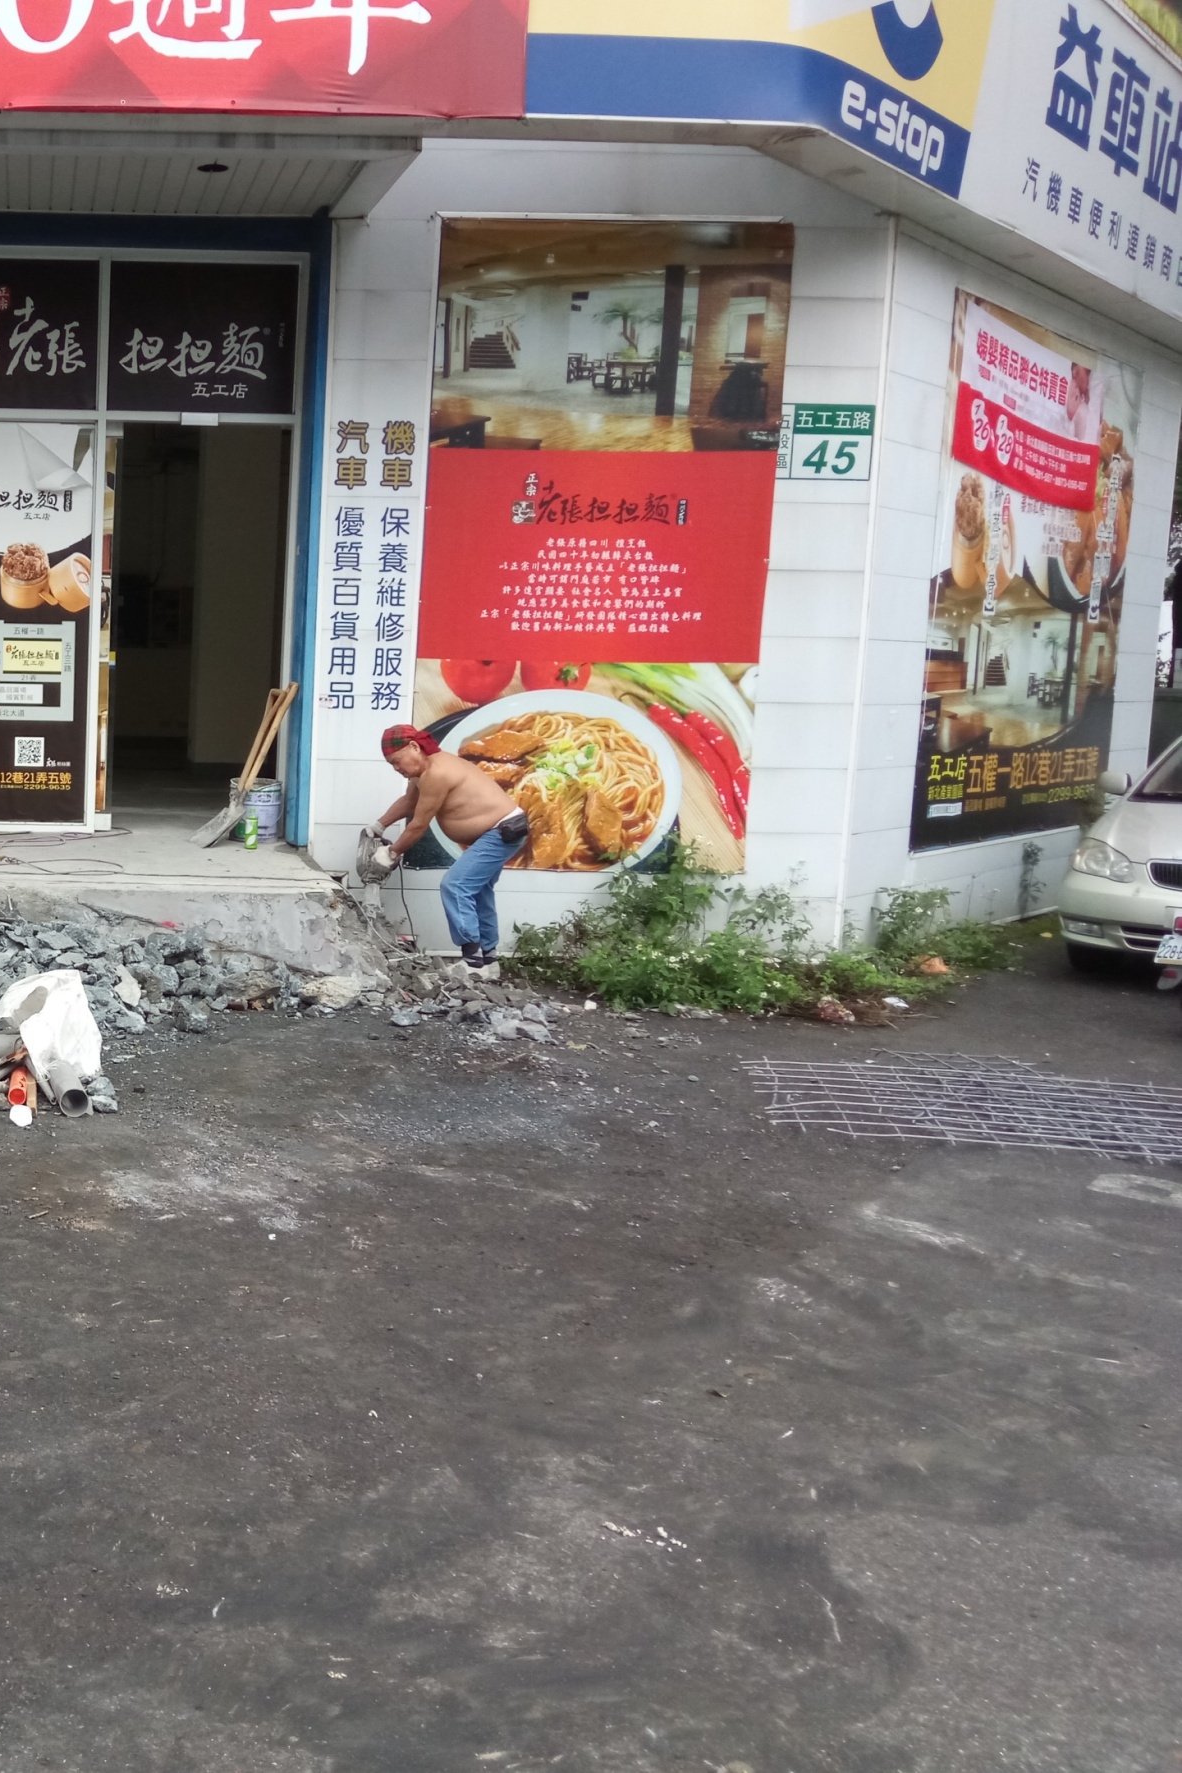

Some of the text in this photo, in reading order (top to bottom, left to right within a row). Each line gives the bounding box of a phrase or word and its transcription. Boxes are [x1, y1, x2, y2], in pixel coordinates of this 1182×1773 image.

[840, 79, 945, 176] e-stop
[191, 382, 249, 399] 五工店
[796, 411, 871, 429] 五工五路
[975, 418, 989, 440] 26
[998, 433, 1012, 455] 28
[802, 440, 859, 475] 45
[525, 472, 538, 496] 正宗
[327, 420, 369, 711] 汽車 優質百貨用品
[370, 420, 415, 711] 機車 保養維修服務
[927, 754, 967, 781] 五工店
